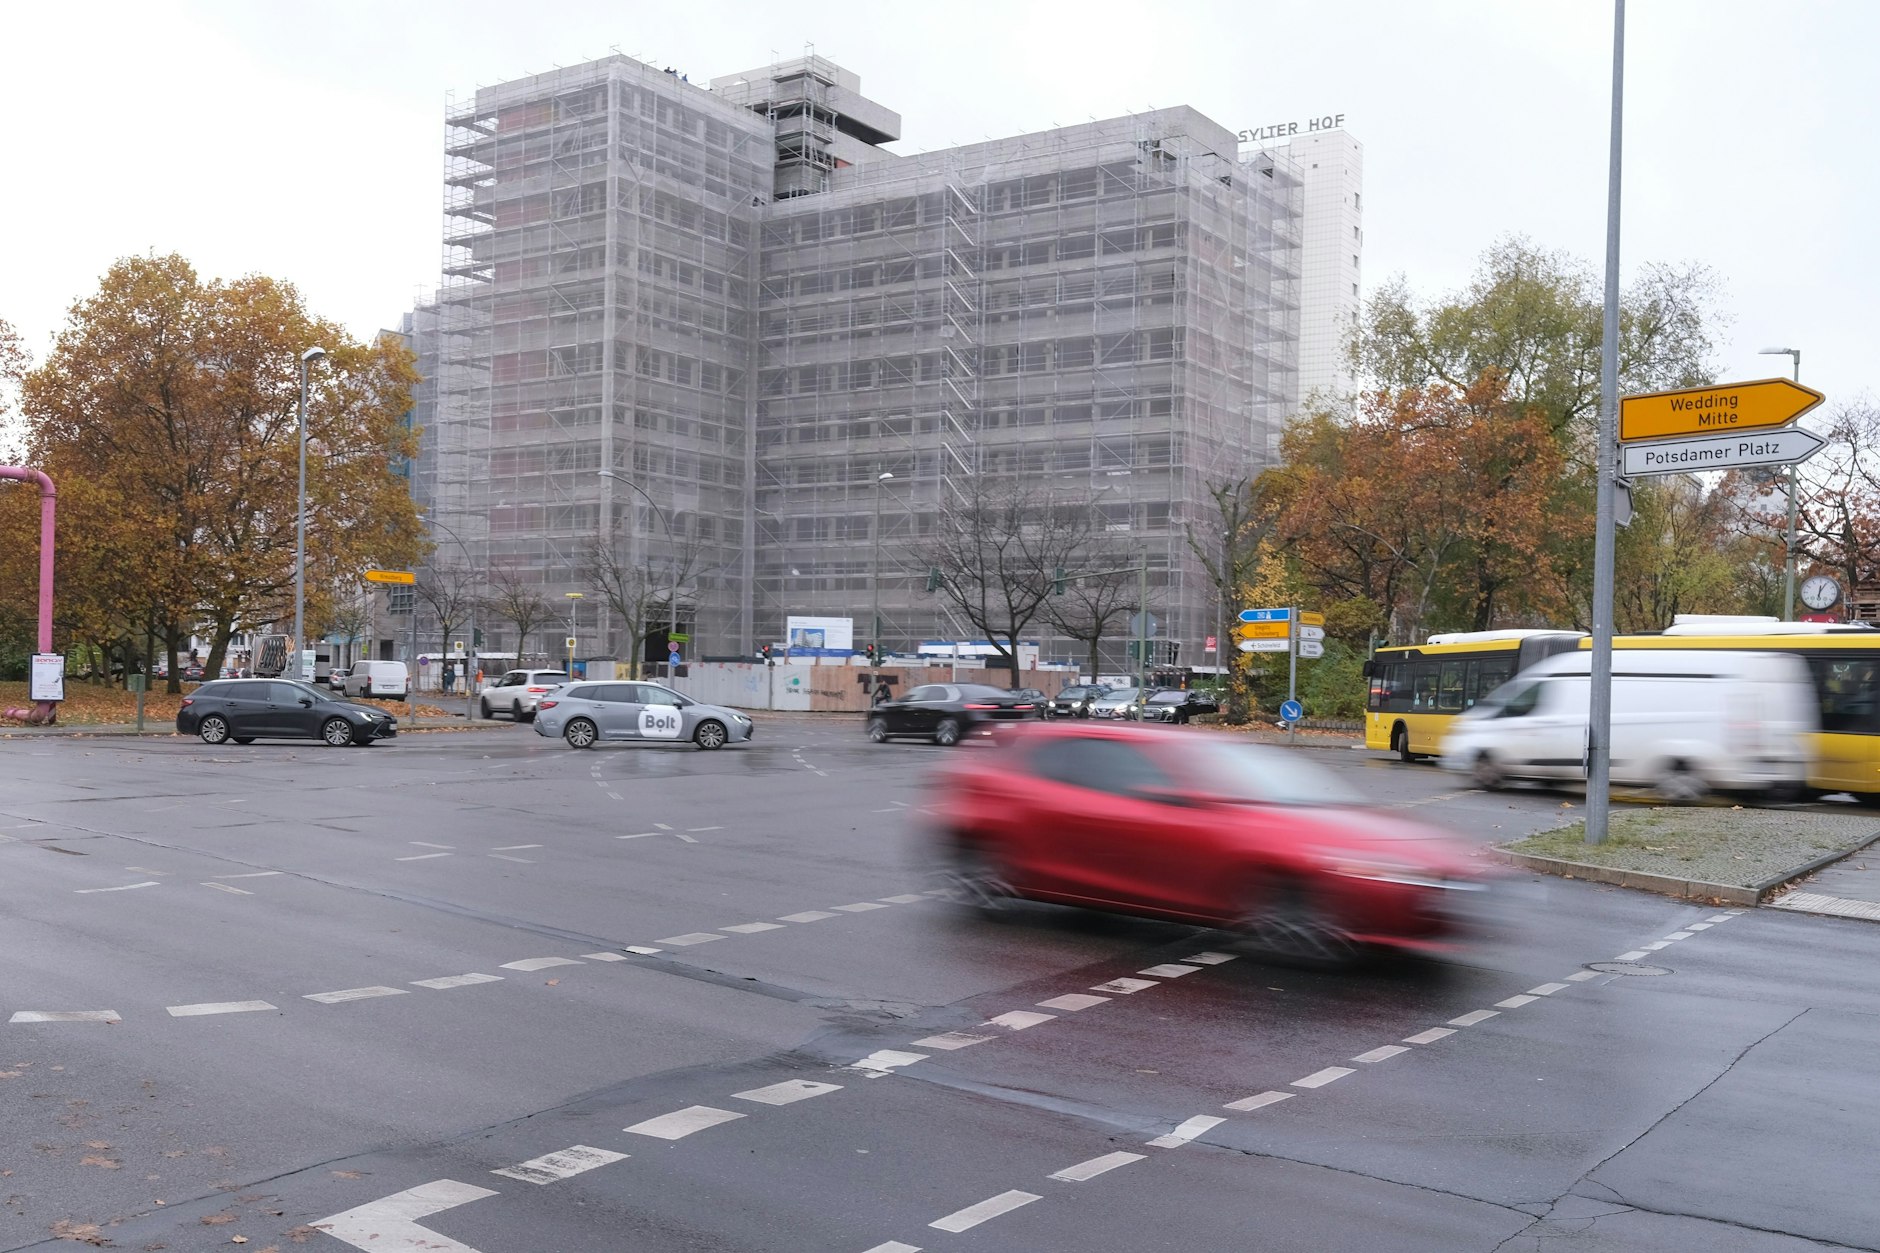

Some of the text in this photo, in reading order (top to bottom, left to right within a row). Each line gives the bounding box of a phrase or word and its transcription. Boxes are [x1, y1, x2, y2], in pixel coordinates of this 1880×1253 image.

[1238, 113, 1345, 143] SYLTER HOF
[1670, 394, 1738, 412] Wedding
[1698, 411, 1738, 426] Mitte
[1645, 442, 1780, 465] Potsdamer Platz
[645, 714, 676, 731] Bolt
